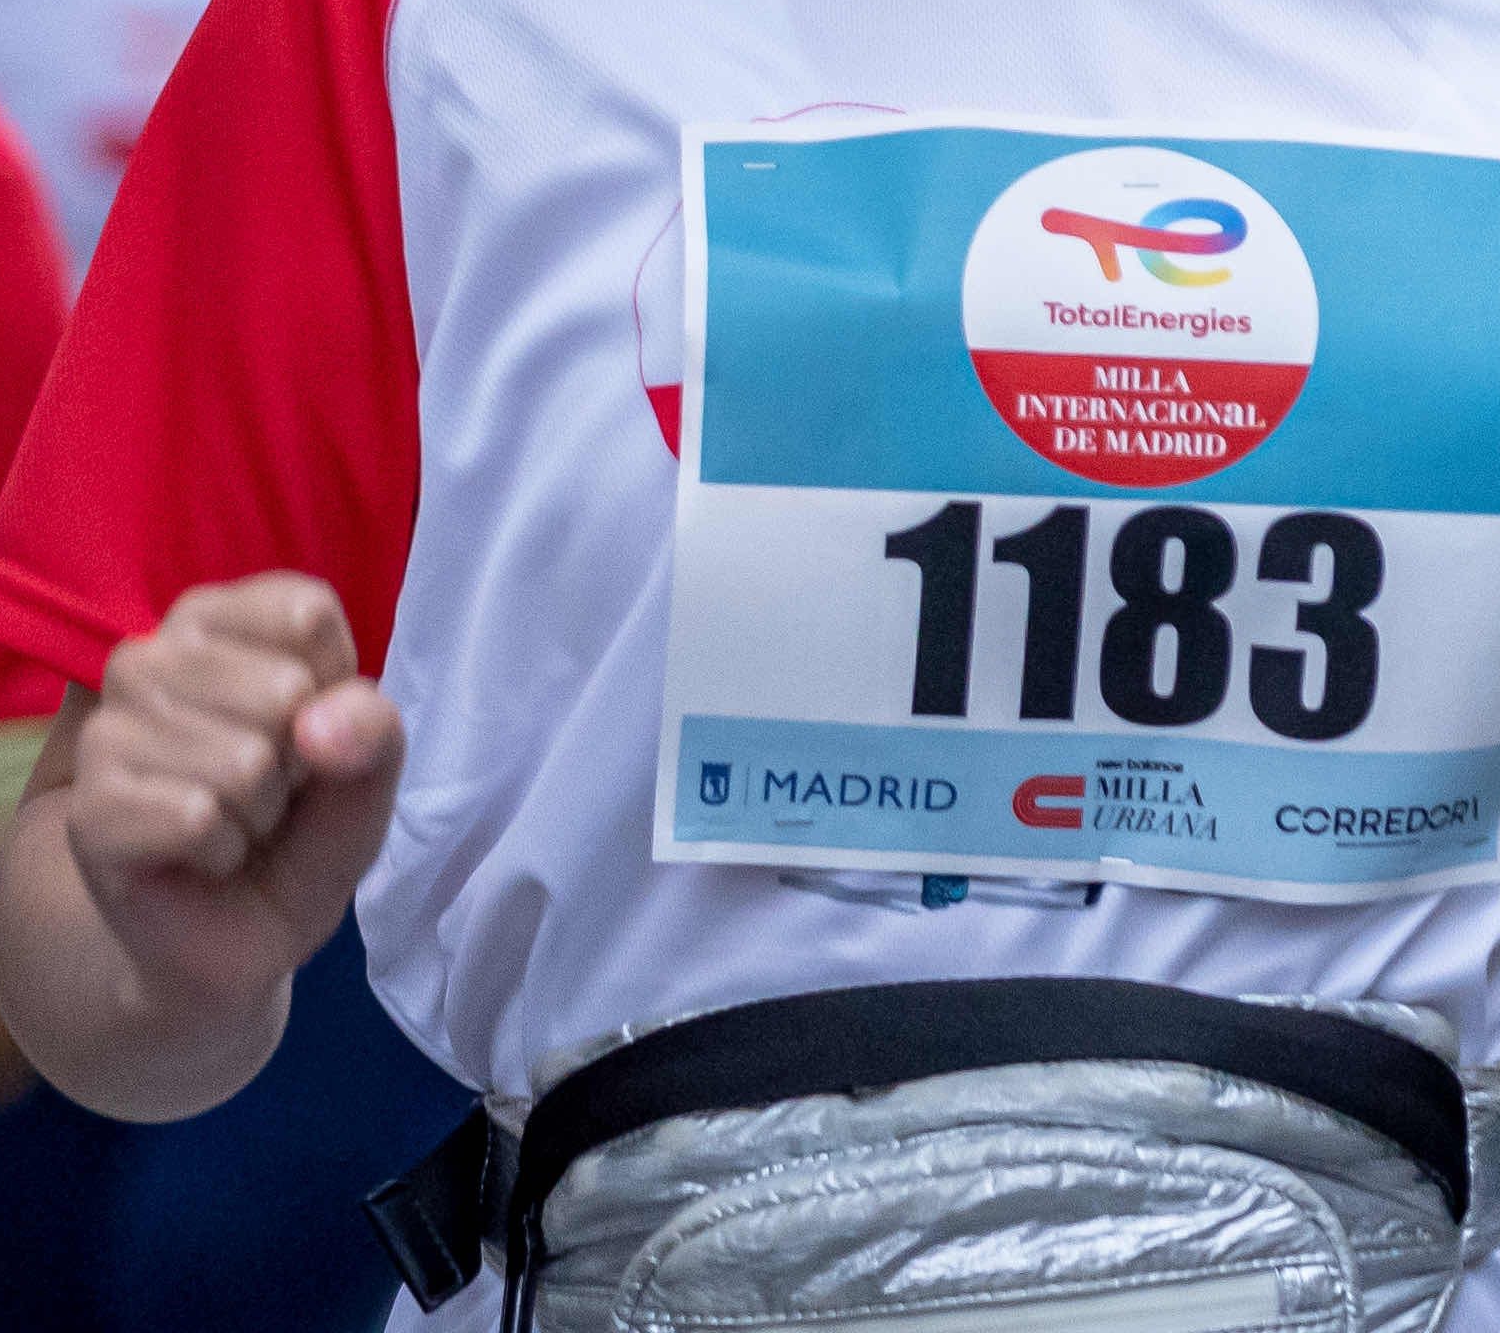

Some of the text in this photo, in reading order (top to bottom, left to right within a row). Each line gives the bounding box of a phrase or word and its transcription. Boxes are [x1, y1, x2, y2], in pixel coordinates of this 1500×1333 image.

[1044, 301, 1252, 338] TotalEnergies
[1094, 366, 1192, 394] MILLA
[1053, 426, 1227, 458] DE MADRID
[885, 500, 1386, 742] 1183
[763, 769, 958, 811] MADRID
[1098, 775, 1204, 807] MILLA
[1094, 804, 1217, 841] URBANA
